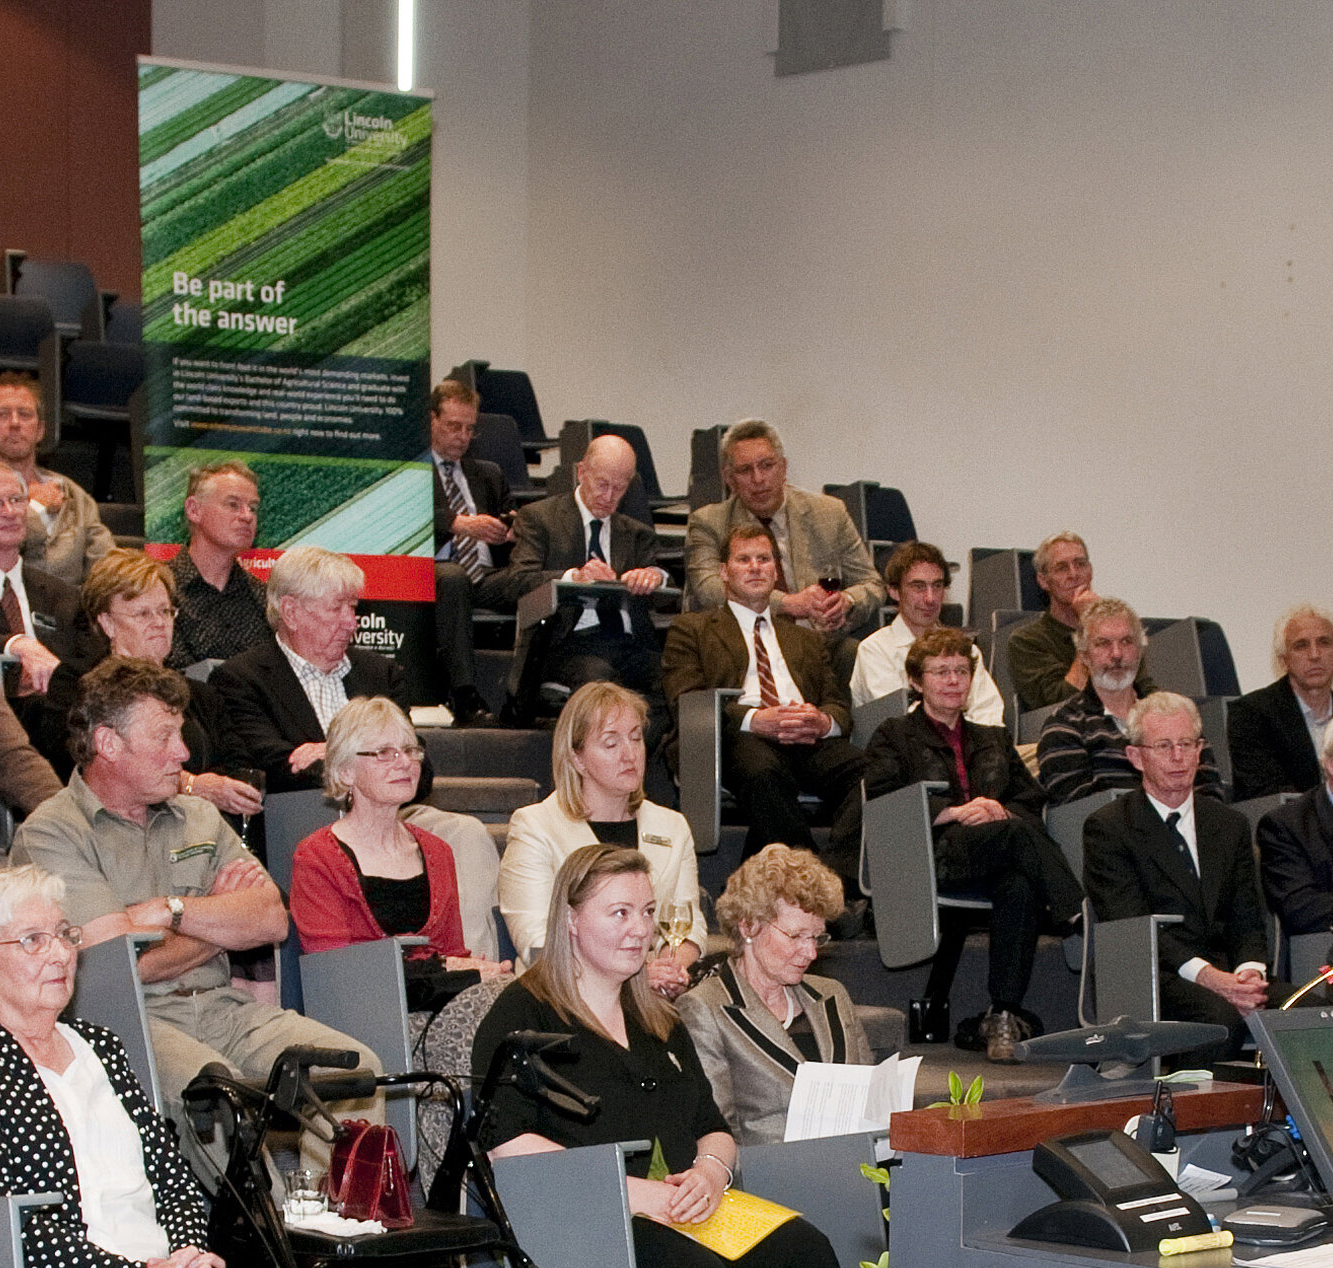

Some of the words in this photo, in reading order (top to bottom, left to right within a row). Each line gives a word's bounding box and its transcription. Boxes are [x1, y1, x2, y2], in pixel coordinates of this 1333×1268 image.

[344, 111, 393, 129] Lincoln
[173, 271, 203, 296] Be
[209, 280, 255, 303] part
[260, 280, 286, 304] of
[172, 302, 211, 327] the
[217, 310, 297, 335] answer
[350, 629, 405, 649] versity
